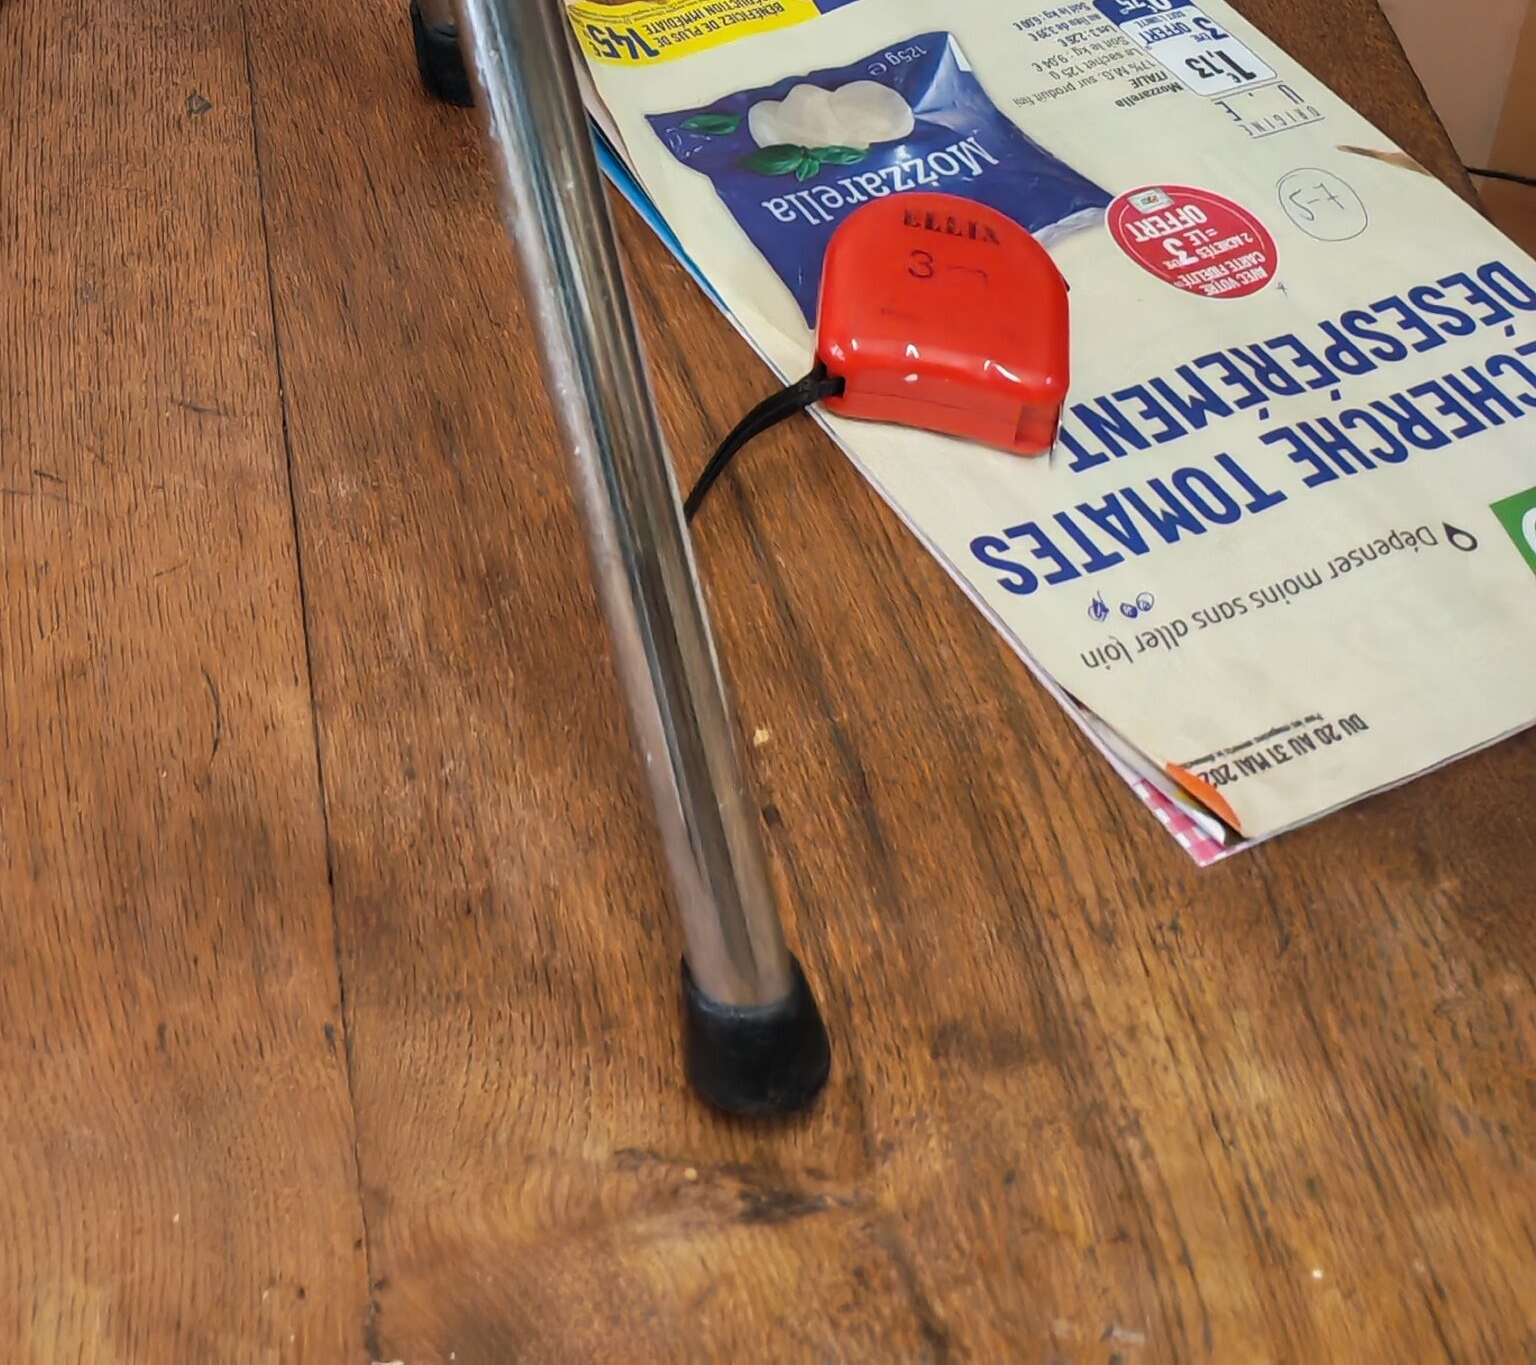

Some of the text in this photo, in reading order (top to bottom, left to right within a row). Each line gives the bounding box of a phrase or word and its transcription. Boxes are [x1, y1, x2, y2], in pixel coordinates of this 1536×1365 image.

[672, 24, 704, 45] PLUS
[1104, 35, 1131, 50] Soit
[1138, 21, 1192, 45] OFFERT
[884, 44, 928, 65] 125g
[1084, 49, 1125, 68] sachet
[1126, 47, 1144, 57] Le
[1035, 81, 1077, 103] produit
[1079, 75, 1099, 90] sur
[1130, 70, 1169, 90] ITALIE
[1114, 82, 1184, 108] Mozzarella
[761, 136, 1000, 226] Mozzarella
[1125, 203, 1209, 243] OFFERT
[1059, 260, 1536, 473] DÉSESPÉRÉMENT
[968, 453, 1288, 596] TOMATES
[1081, 524, 1439, 672] Dépenser moins sans aller loin
[1313, 724, 1343, 746] 20
[1340, 712, 1369, 736] DU
[1288, 733, 1318, 757] AU
[1235, 752, 1272, 778] MAI
